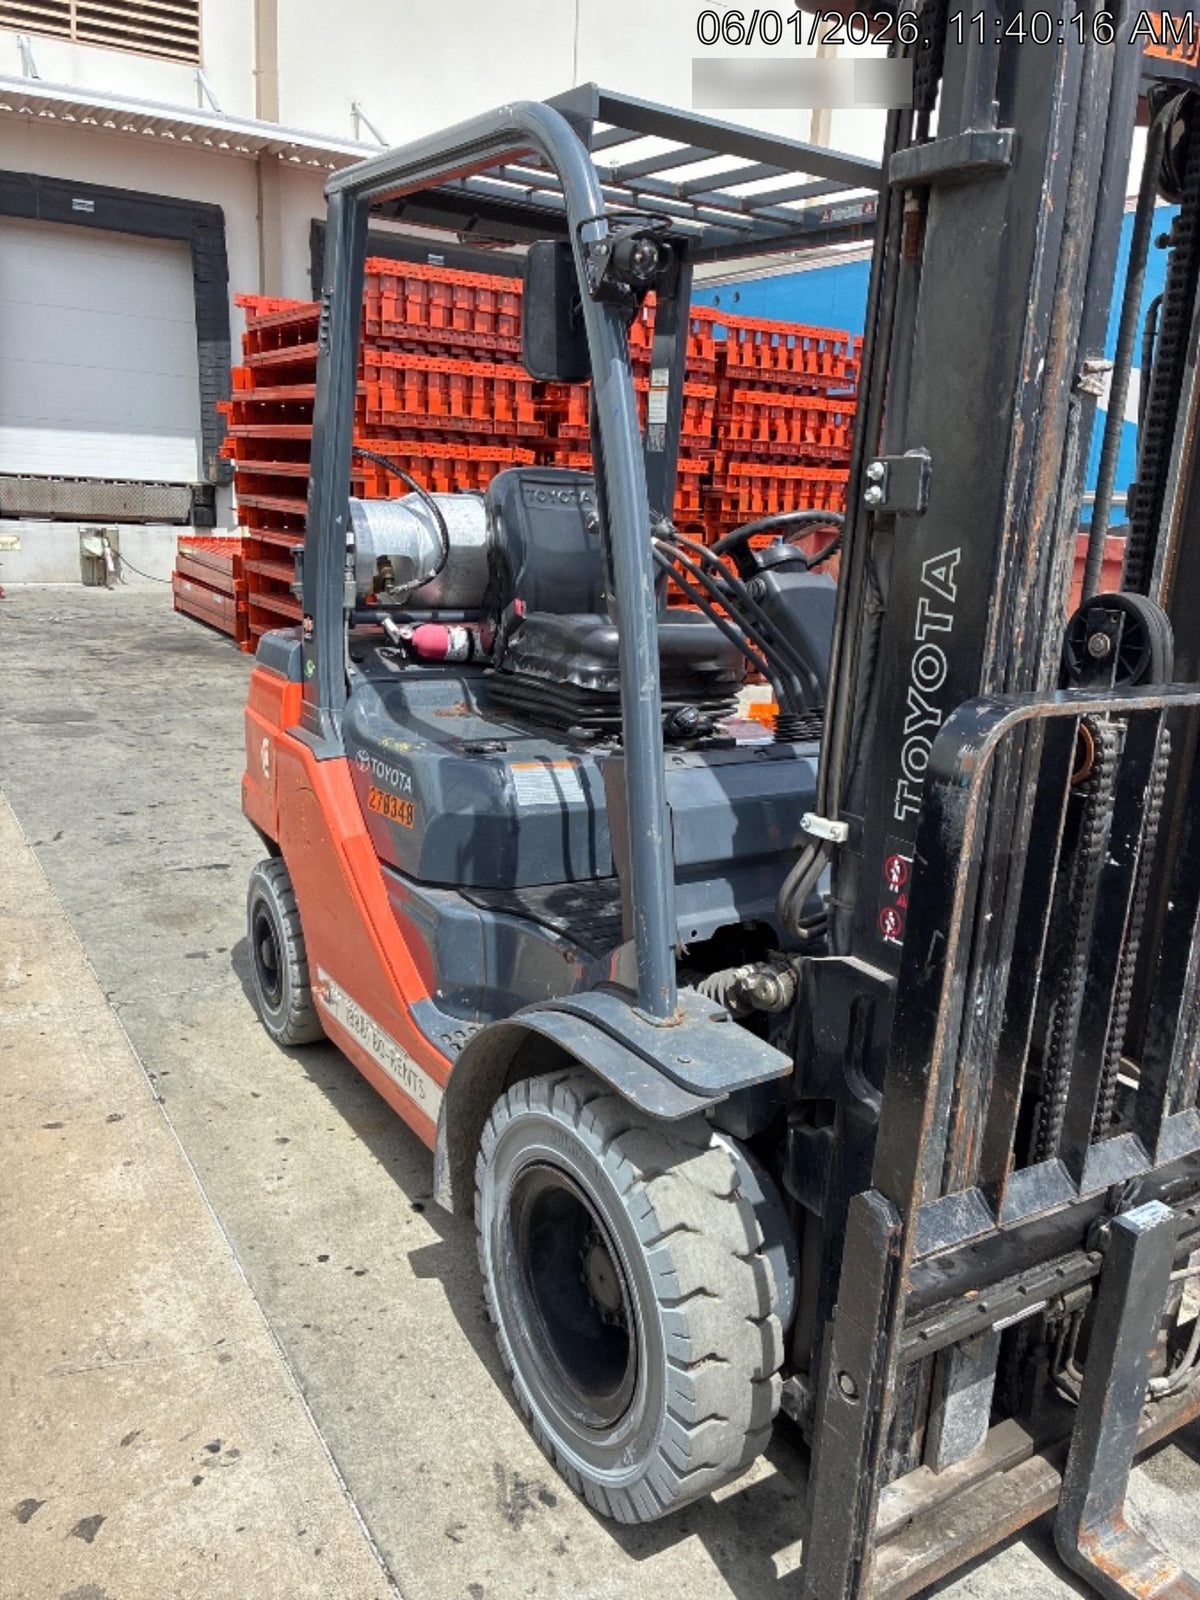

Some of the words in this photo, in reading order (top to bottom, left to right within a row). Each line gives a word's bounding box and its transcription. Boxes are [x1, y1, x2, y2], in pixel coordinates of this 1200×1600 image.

[526, 489, 593, 505] TOYOTA
[894, 547, 961, 820] TOYOTA
[371, 758, 412, 794] TOYOTA
